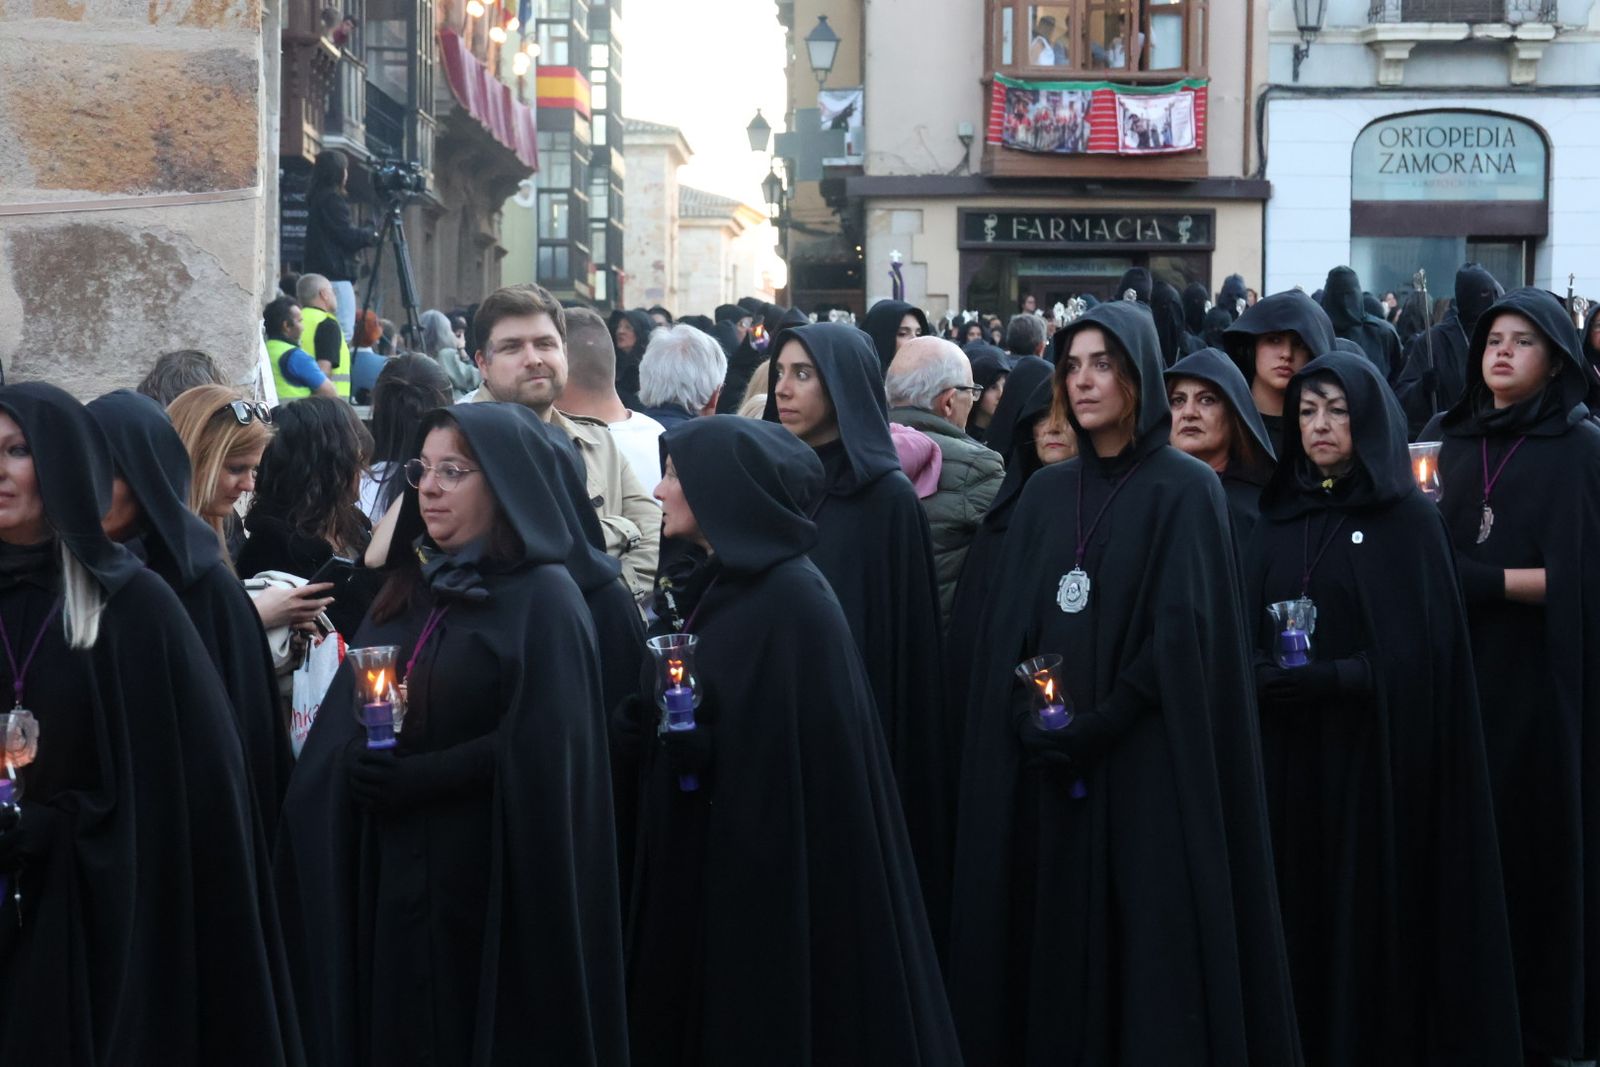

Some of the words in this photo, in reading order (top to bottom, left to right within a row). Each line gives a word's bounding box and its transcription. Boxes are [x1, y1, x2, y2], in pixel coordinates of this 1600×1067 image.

[1378, 126, 1516, 148] ORTOPEDIA
[1378, 152, 1517, 174] ZAMORANA
[1012, 217, 1162, 240] FARMACIA
